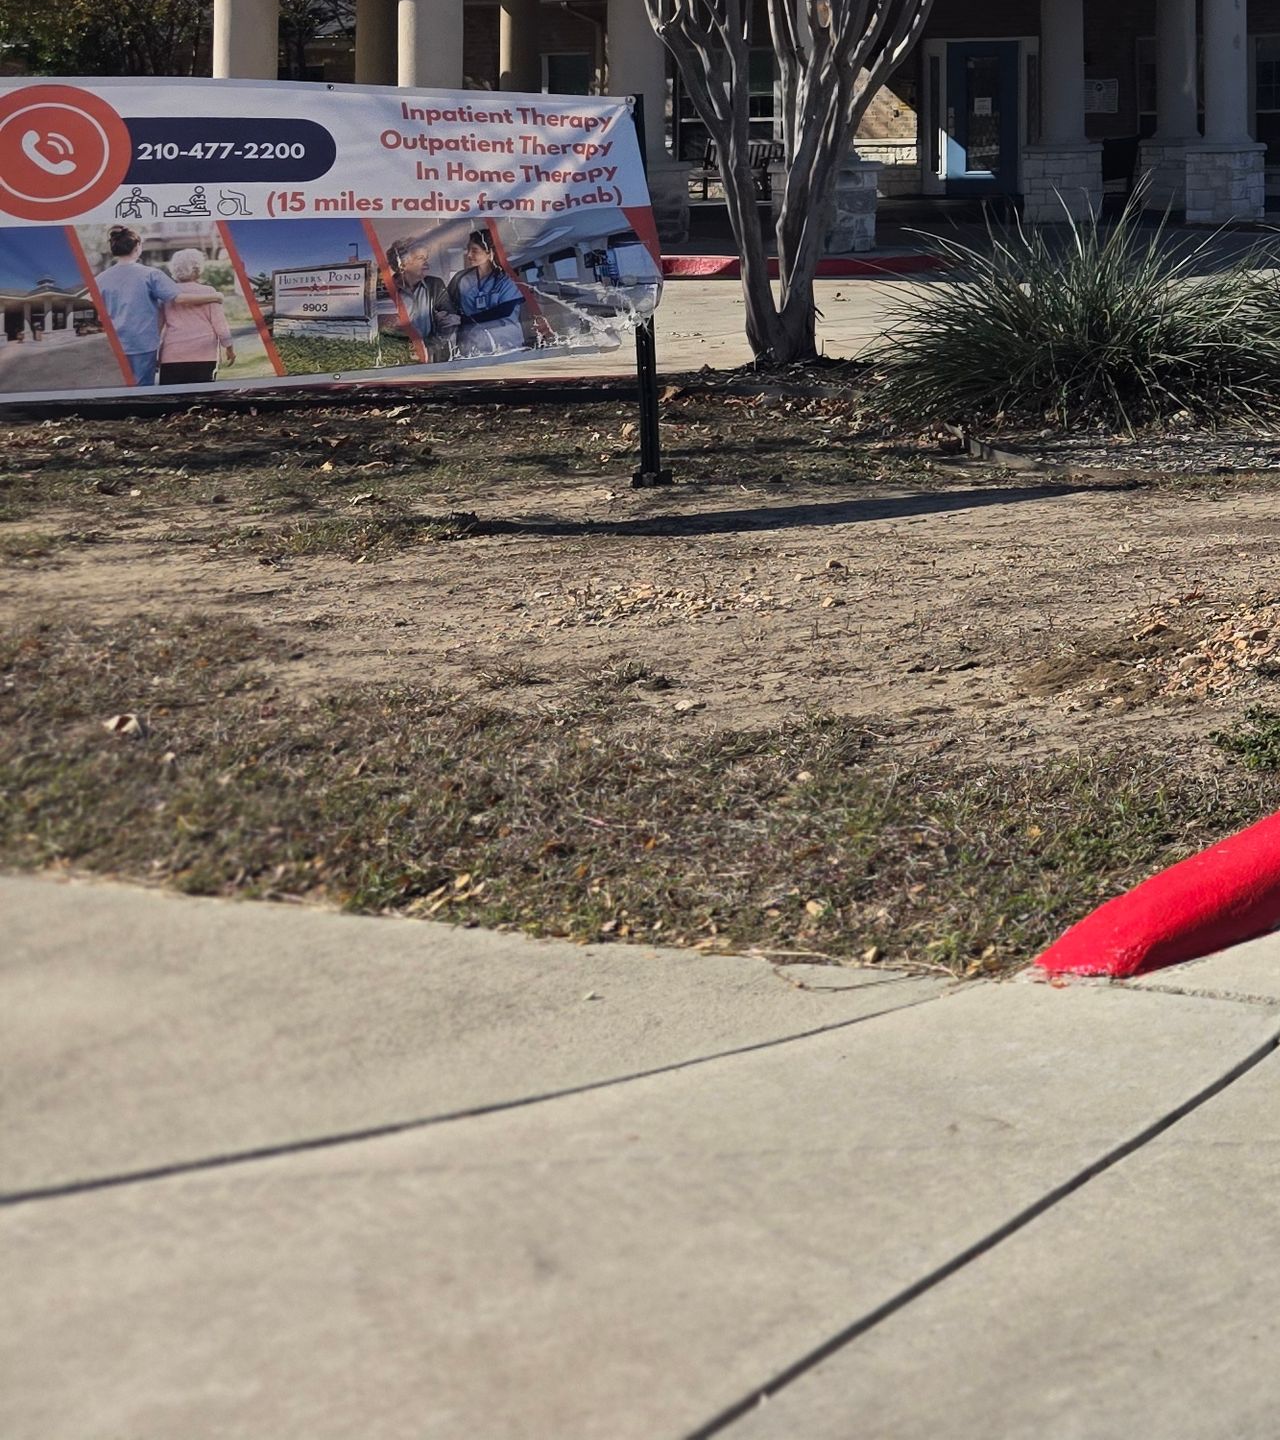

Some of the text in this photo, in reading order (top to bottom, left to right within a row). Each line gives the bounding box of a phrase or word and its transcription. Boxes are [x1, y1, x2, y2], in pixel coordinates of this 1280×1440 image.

[401, 102, 613, 133] Inpatient Therapy
[137, 142, 306, 160] 210-477-2200
[380, 129, 614, 160] Outpatient Therapy
[416, 161, 618, 183] In Home Therapy
[266, 185, 623, 217] (15 miles radius from rehab)
[328, 271, 361, 283] POND
[302, 303, 328, 312] 9903
